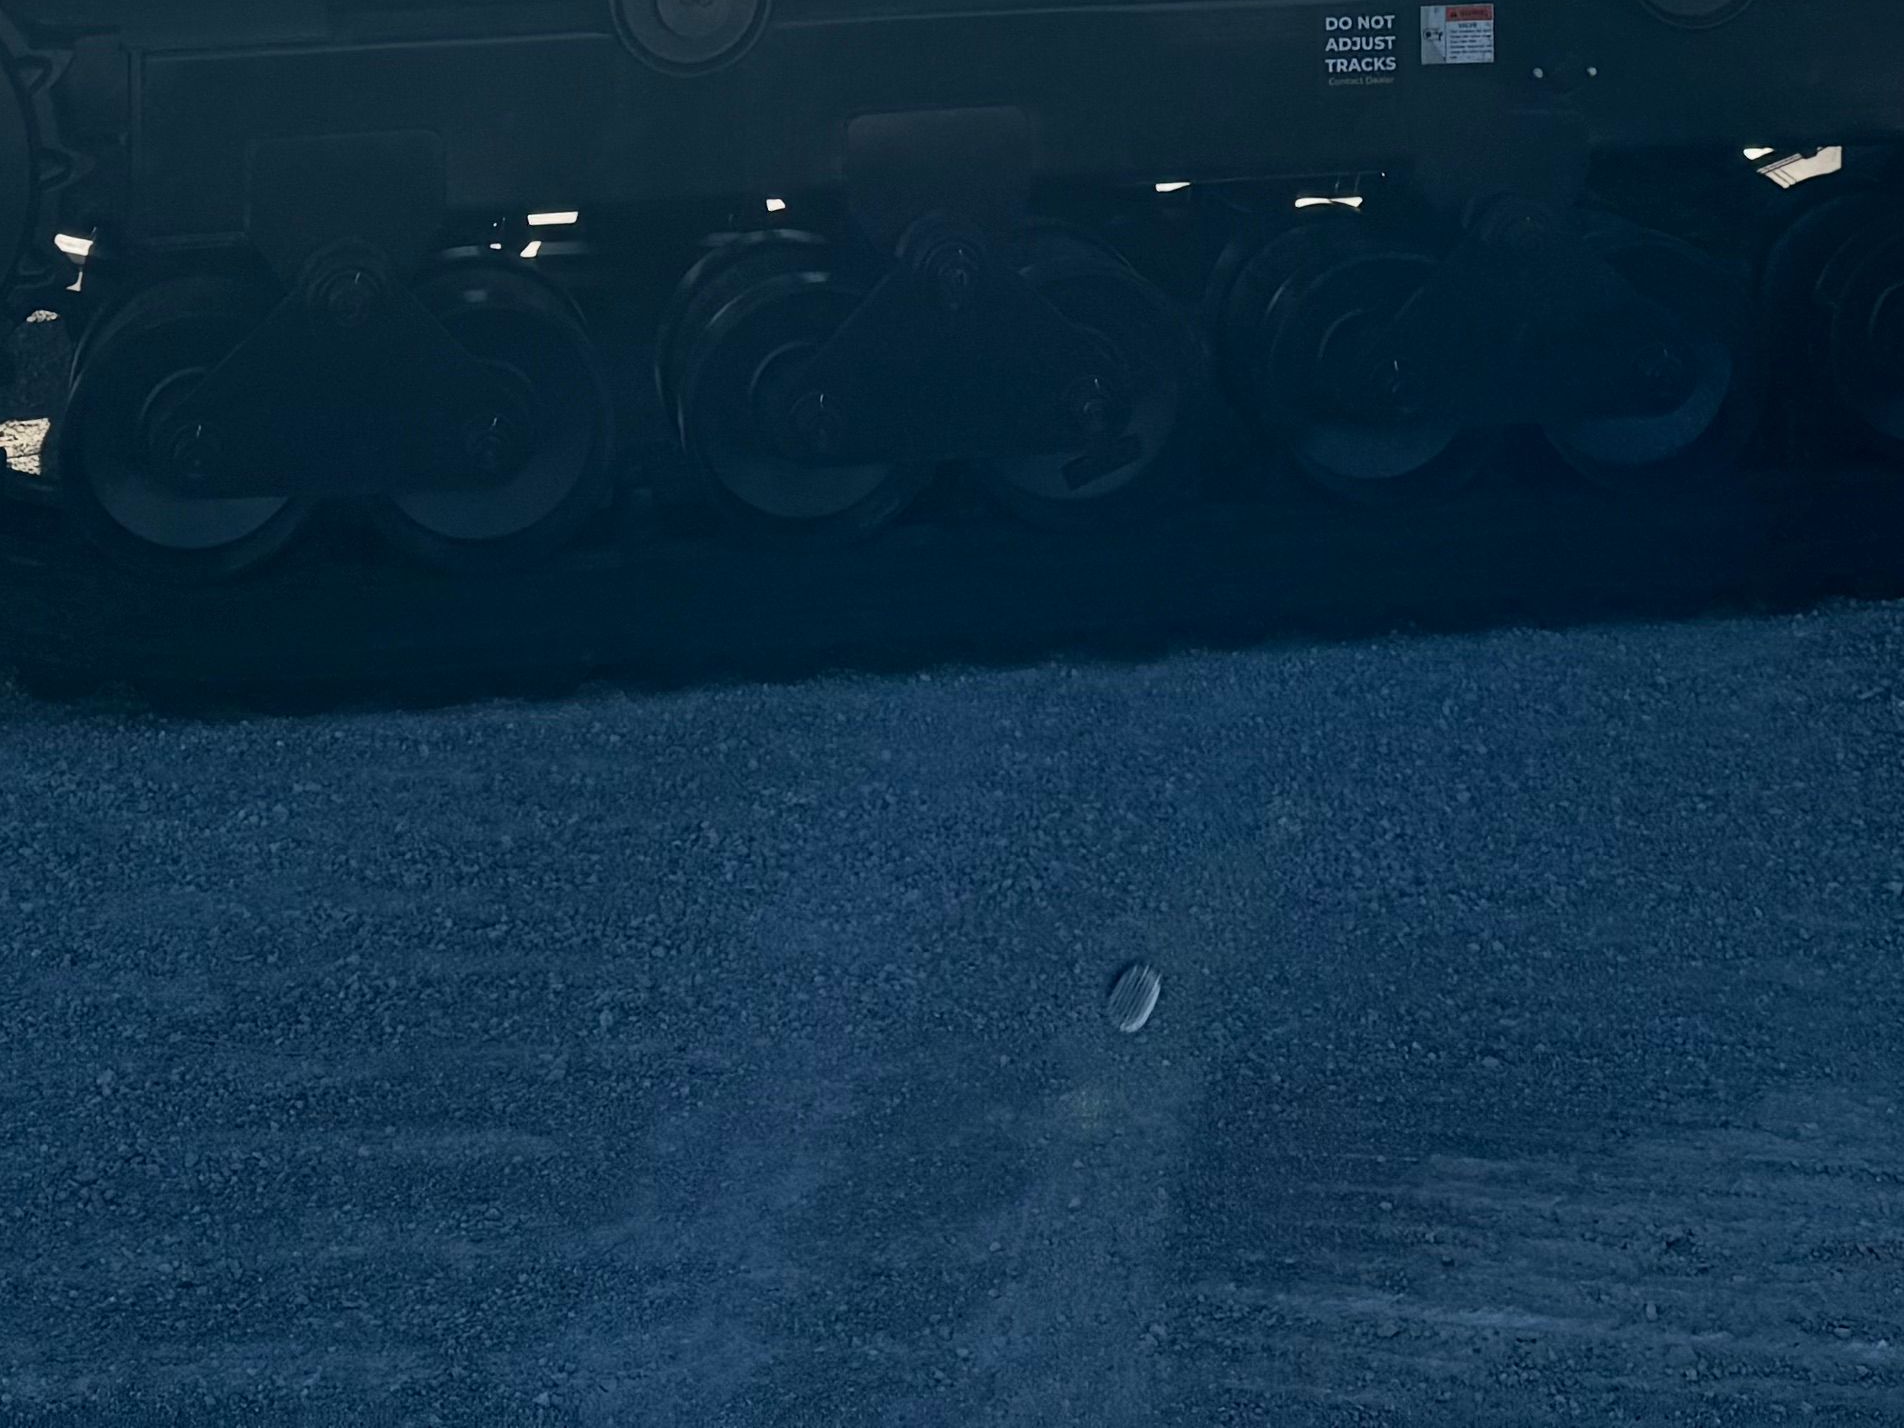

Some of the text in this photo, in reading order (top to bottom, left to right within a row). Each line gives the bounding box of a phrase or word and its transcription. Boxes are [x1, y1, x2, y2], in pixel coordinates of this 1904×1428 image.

[1325, 14, 1396, 31] DO NOT
[1325, 35, 1396, 52] ADJUST
[1324, 56, 1397, 73] TRACKS
